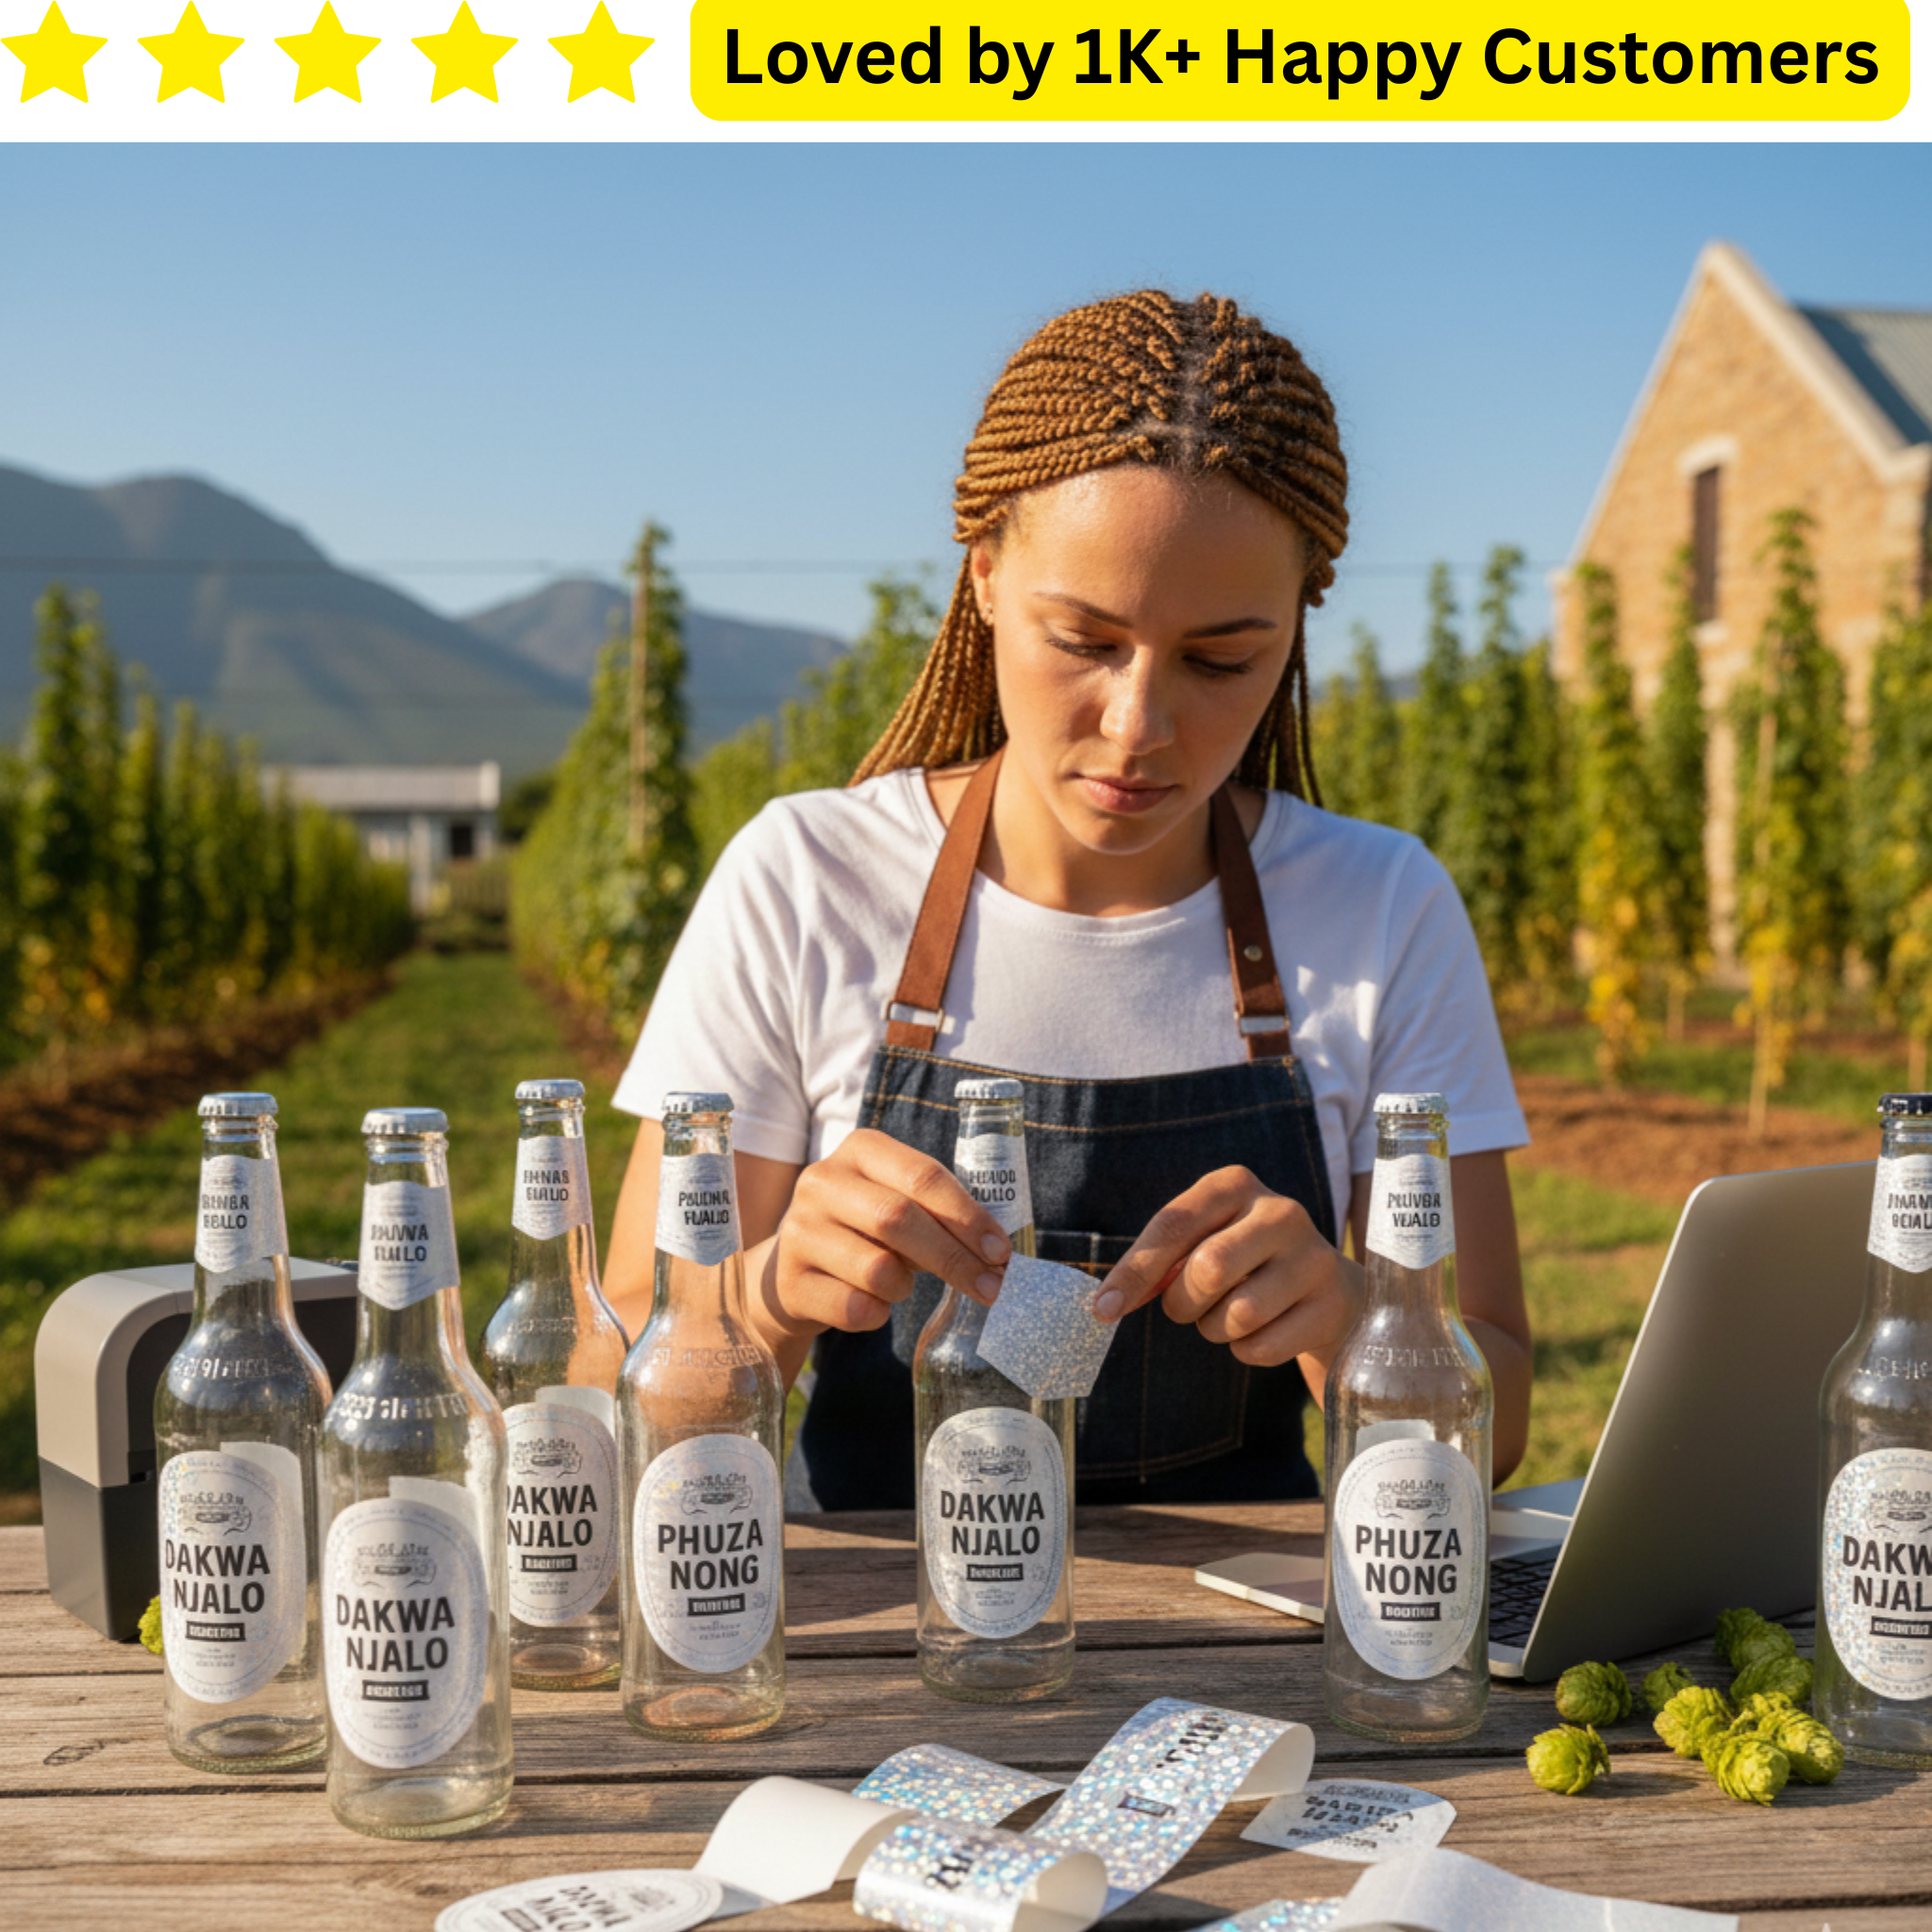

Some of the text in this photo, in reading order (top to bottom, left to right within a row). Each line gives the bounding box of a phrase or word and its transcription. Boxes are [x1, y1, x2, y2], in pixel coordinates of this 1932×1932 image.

[507, 1485, 598, 1516] AKWA
[941, 1491, 1045, 1524] DAKWA
[507, 1519, 593, 1548] NJALO
[658, 1519, 763, 1556] PHUZA
[952, 1525, 1041, 1556] NJALO
[1356, 1524, 1462, 1559] PHUZA
[165, 1540, 271, 1577] DAKWA
[671, 1555, 759, 1591] NONG
[1365, 1562, 1457, 1595] NONG
[174, 1579, 265, 1614] NJALO
[336, 1593, 455, 1633] DAKWA
[346, 1637, 449, 1673] NJALO
